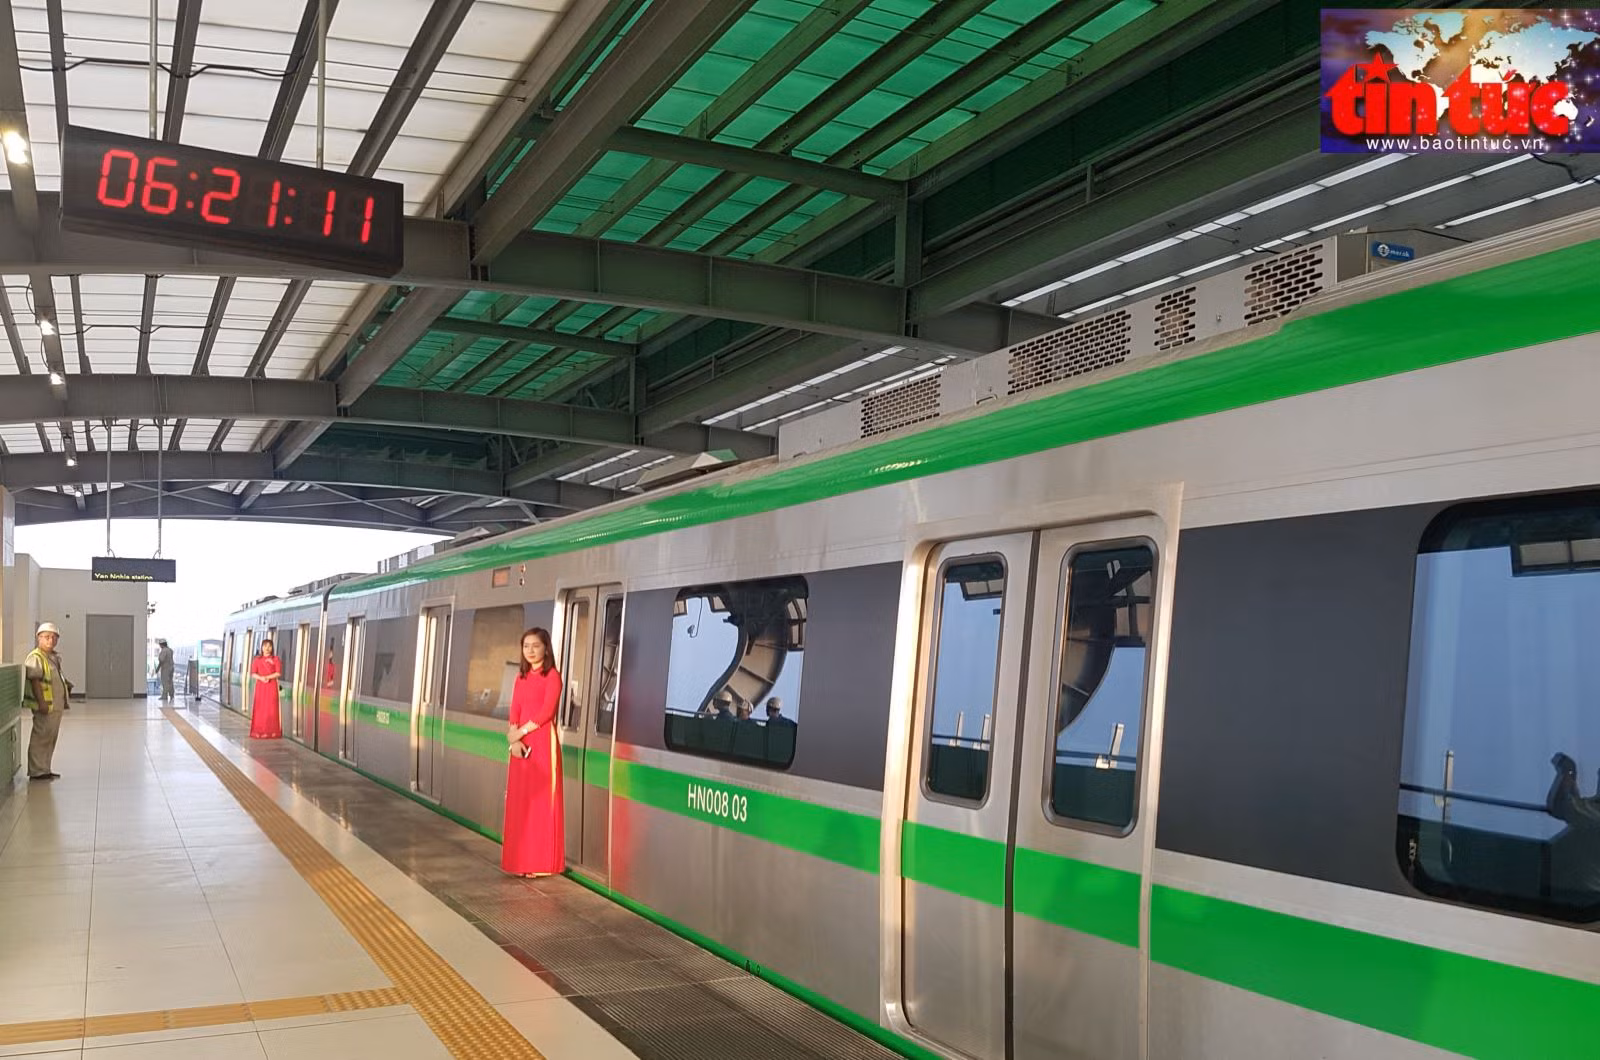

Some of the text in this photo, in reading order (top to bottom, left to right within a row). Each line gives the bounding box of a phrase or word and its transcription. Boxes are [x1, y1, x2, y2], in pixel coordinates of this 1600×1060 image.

[96, 148, 375, 245] 06:21:11
[687, 783, 748, 823] HN008 03
